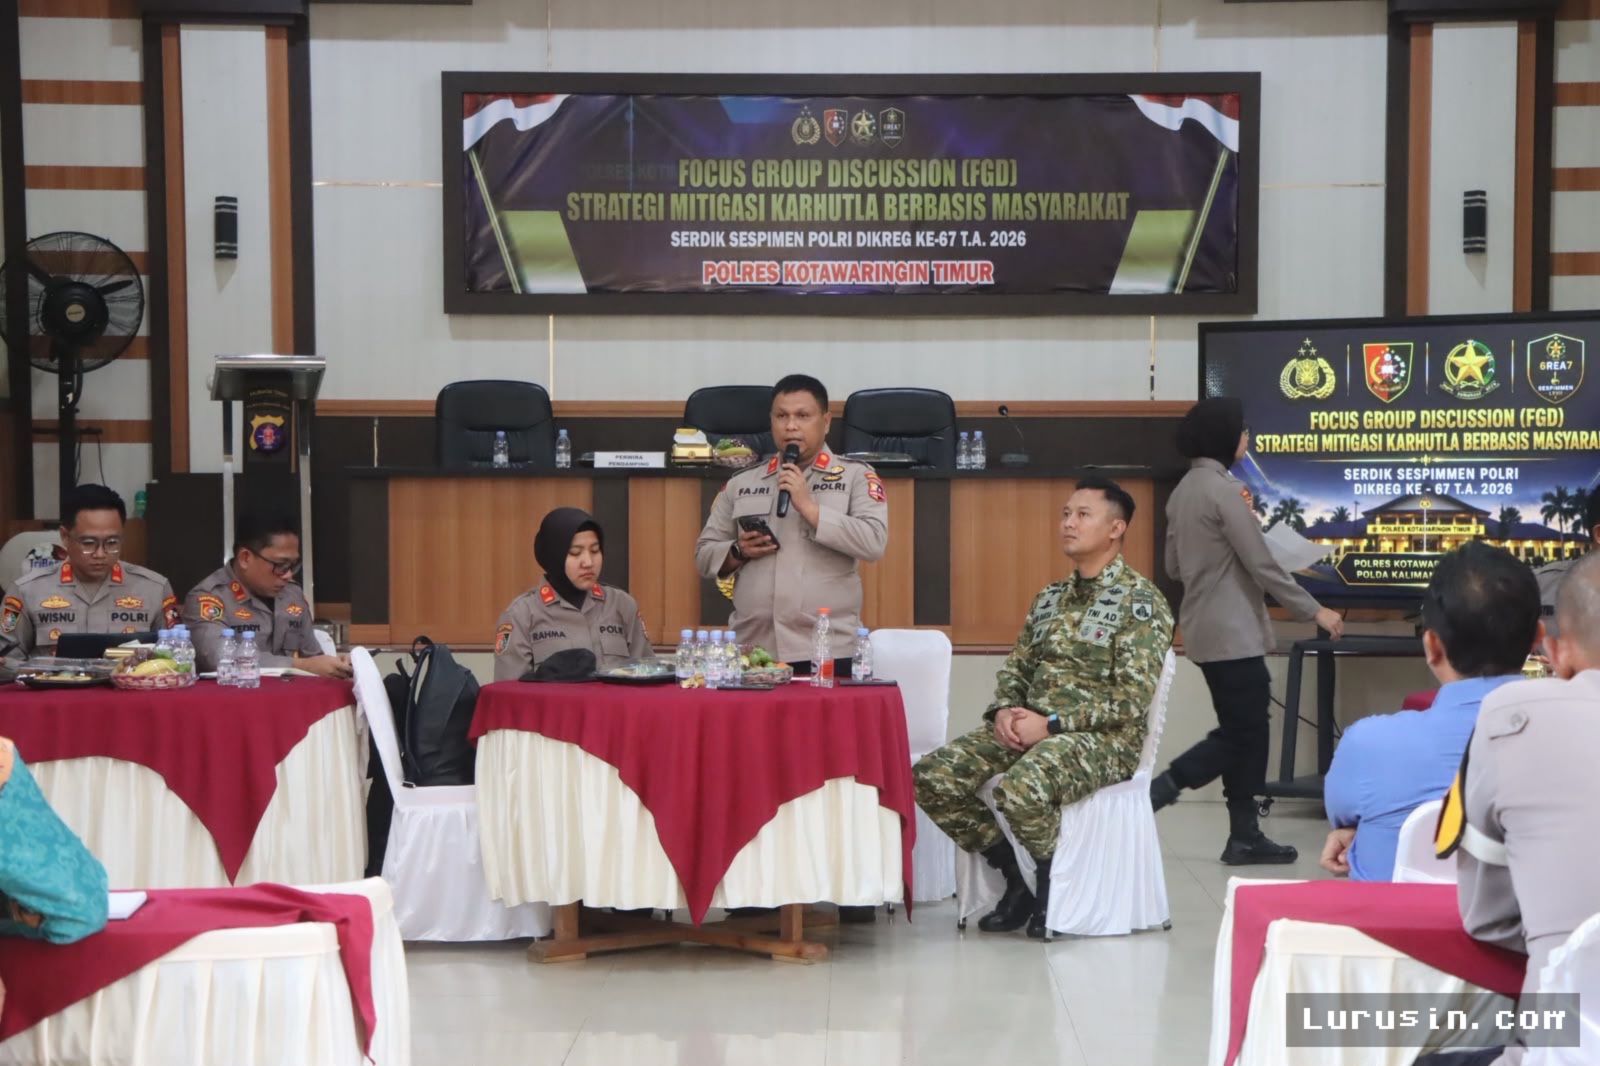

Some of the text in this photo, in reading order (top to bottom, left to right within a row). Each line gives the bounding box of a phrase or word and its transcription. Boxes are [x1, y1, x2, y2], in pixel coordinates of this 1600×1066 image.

[678, 159, 1017, 188] FOCUS GROUP DISCUSSION (FGD)
[567, 192, 1130, 221] STRATEGI MITIGASI KARHUTLA BERBASIS MASYARAKAT
[670, 231, 1026, 248] SERDIK SESPIMEN POLRI DIKREG KE-67 T.A. 2026
[702, 260, 994, 285] POLRES KOTAWARINGIN TIMUR
[1540, 361, 1573, 370] 6REA7
[1310, 407, 1564, 430] FOCUS GROUP DISCUSSION (FGD)
[1255, 430, 1600, 452] STRATEGI MITIGASI KARHUTLA BERBASIS MASYARA
[1344, 467, 1519, 481] SERDIK SESPIMMEN POLRI
[738, 487, 770, 496] FAJRI
[812, 483, 845, 492] POLRI
[1354, 483, 1401, 495] DIKREG
[1406, 483, 1422, 494] KE
[1435, 483, 1449, 494] 67
[1454, 483, 1477, 494] T.A.
[1481, 483, 1513, 494] 2026
[1353, 559, 1391, 568] POLRES
[1356, 570, 1388, 579] POLDA
[38, 613, 75, 623] WISNU
[111, 612, 148, 622] POLRI
[1087, 608, 1117, 621] TNI AD
[600, 625, 624, 634] POLR
[532, 631, 566, 641] RAHMA
